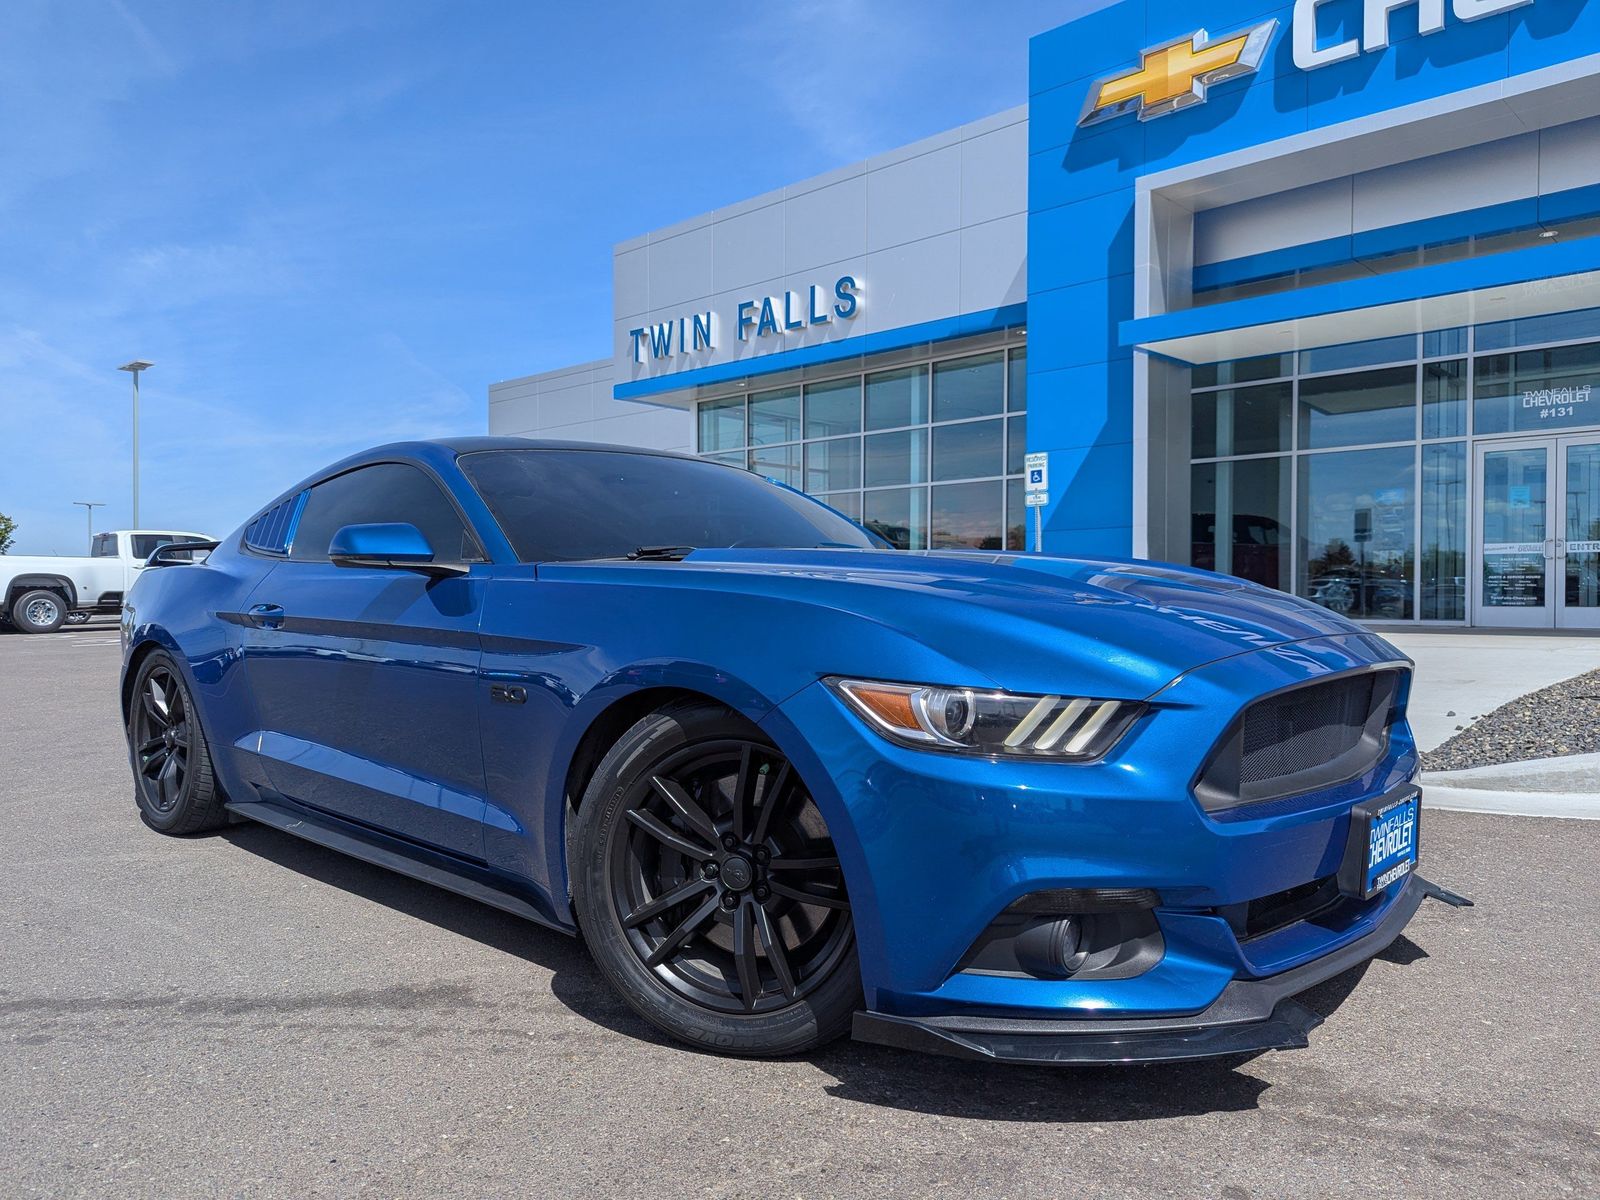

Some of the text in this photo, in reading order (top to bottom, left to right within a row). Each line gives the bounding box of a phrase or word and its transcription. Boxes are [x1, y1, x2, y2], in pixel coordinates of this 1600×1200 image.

[630, 276, 861, 363] TWIN FALLS
[1522, 391, 1591, 408] CHEVROLET
[1523, 385, 1591, 398] TWINFALLS
[1540, 406, 1574, 418] #131
[1370, 807, 1414, 845] TWINFALLS
